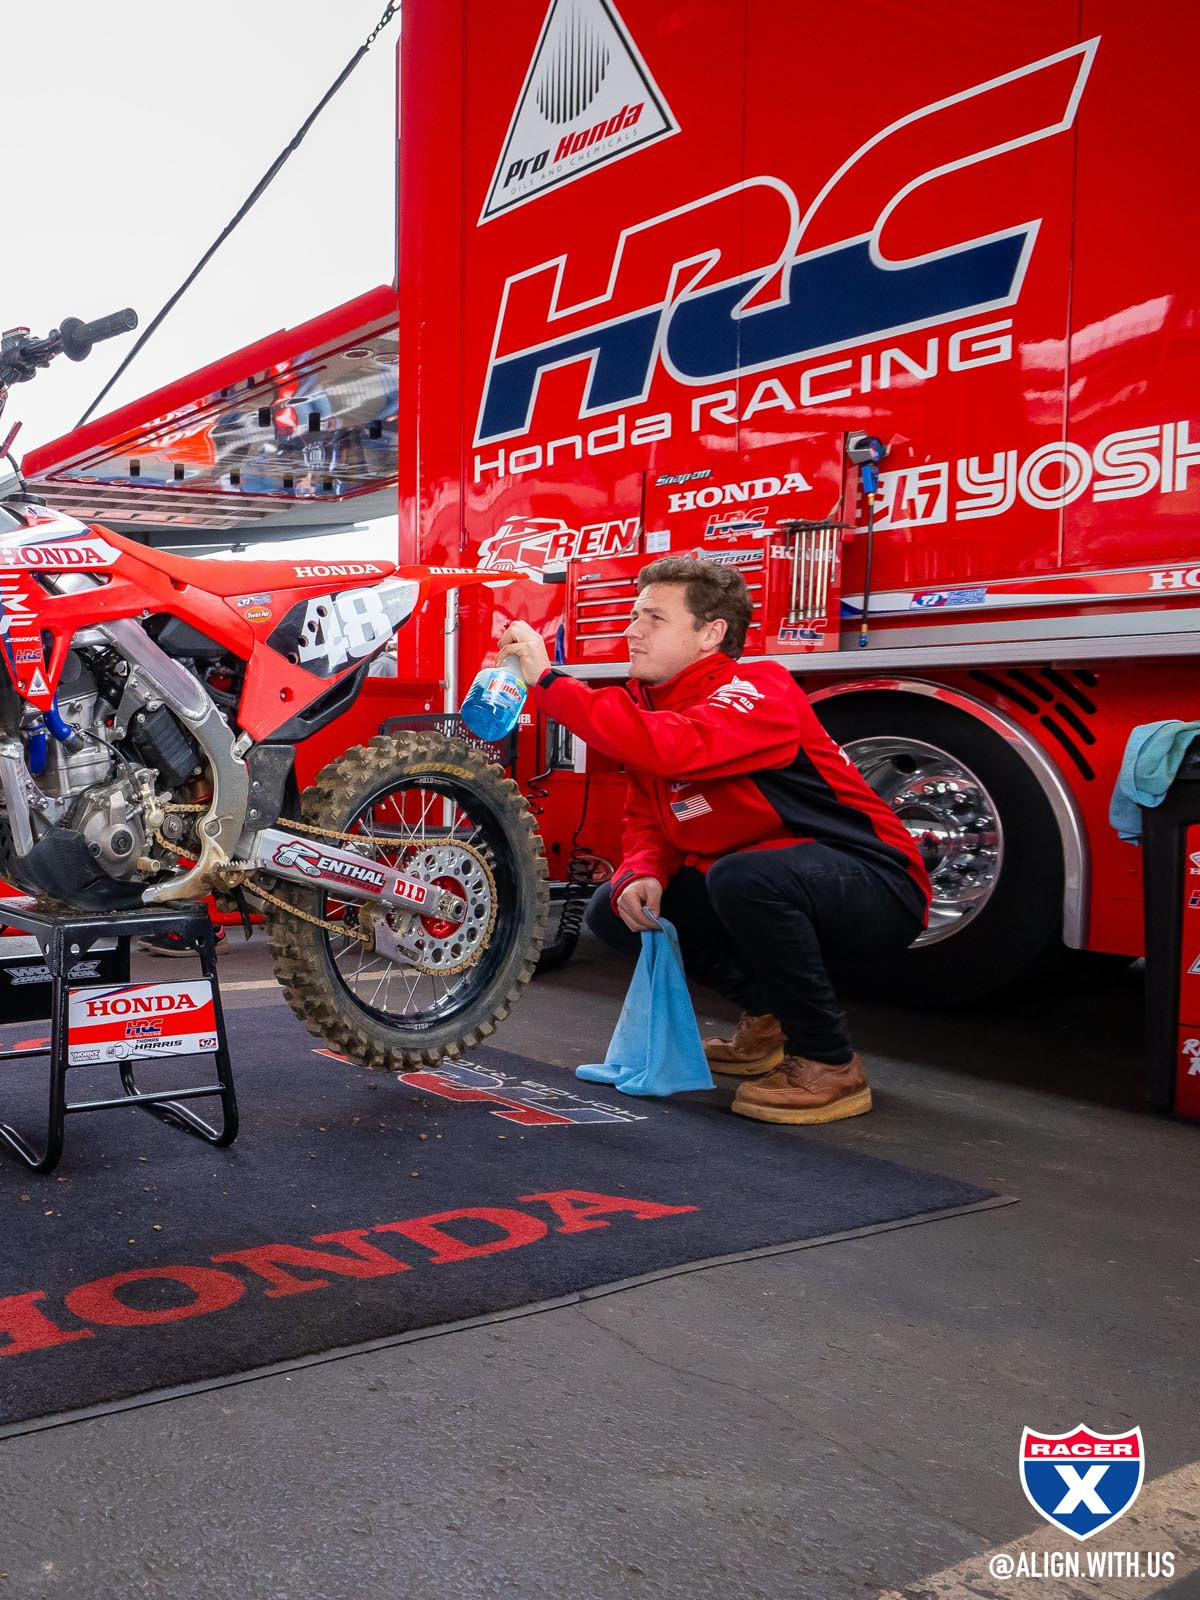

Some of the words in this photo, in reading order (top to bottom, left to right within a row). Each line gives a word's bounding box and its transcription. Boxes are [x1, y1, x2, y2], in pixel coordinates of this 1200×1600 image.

[503, 149, 550, 189] Pro
[552, 102, 645, 164] Honda
[510, 180, 535, 195] OILS
[541, 165, 563, 179] AND
[570, 129, 639, 166] CHEMICALS
[472, 36, 1101, 449] HRC
[473, 411, 672, 484] Honda
[691, 318, 1014, 434] RACING
[656, 469, 712, 486] Snap-on
[668, 472, 813, 513] HONDA
[704, 506, 769, 537] HRC
[293, 563, 383, 578] HONDA
[298, 587, 393, 672] 48
[778, 617, 828, 640] HRC
[487, 678, 522, 701] Wnde
[86, 994, 198, 1018] HONDA
[125, 1018, 163, 1035] HRC
[135, 1040, 182, 1050] HARRIS
